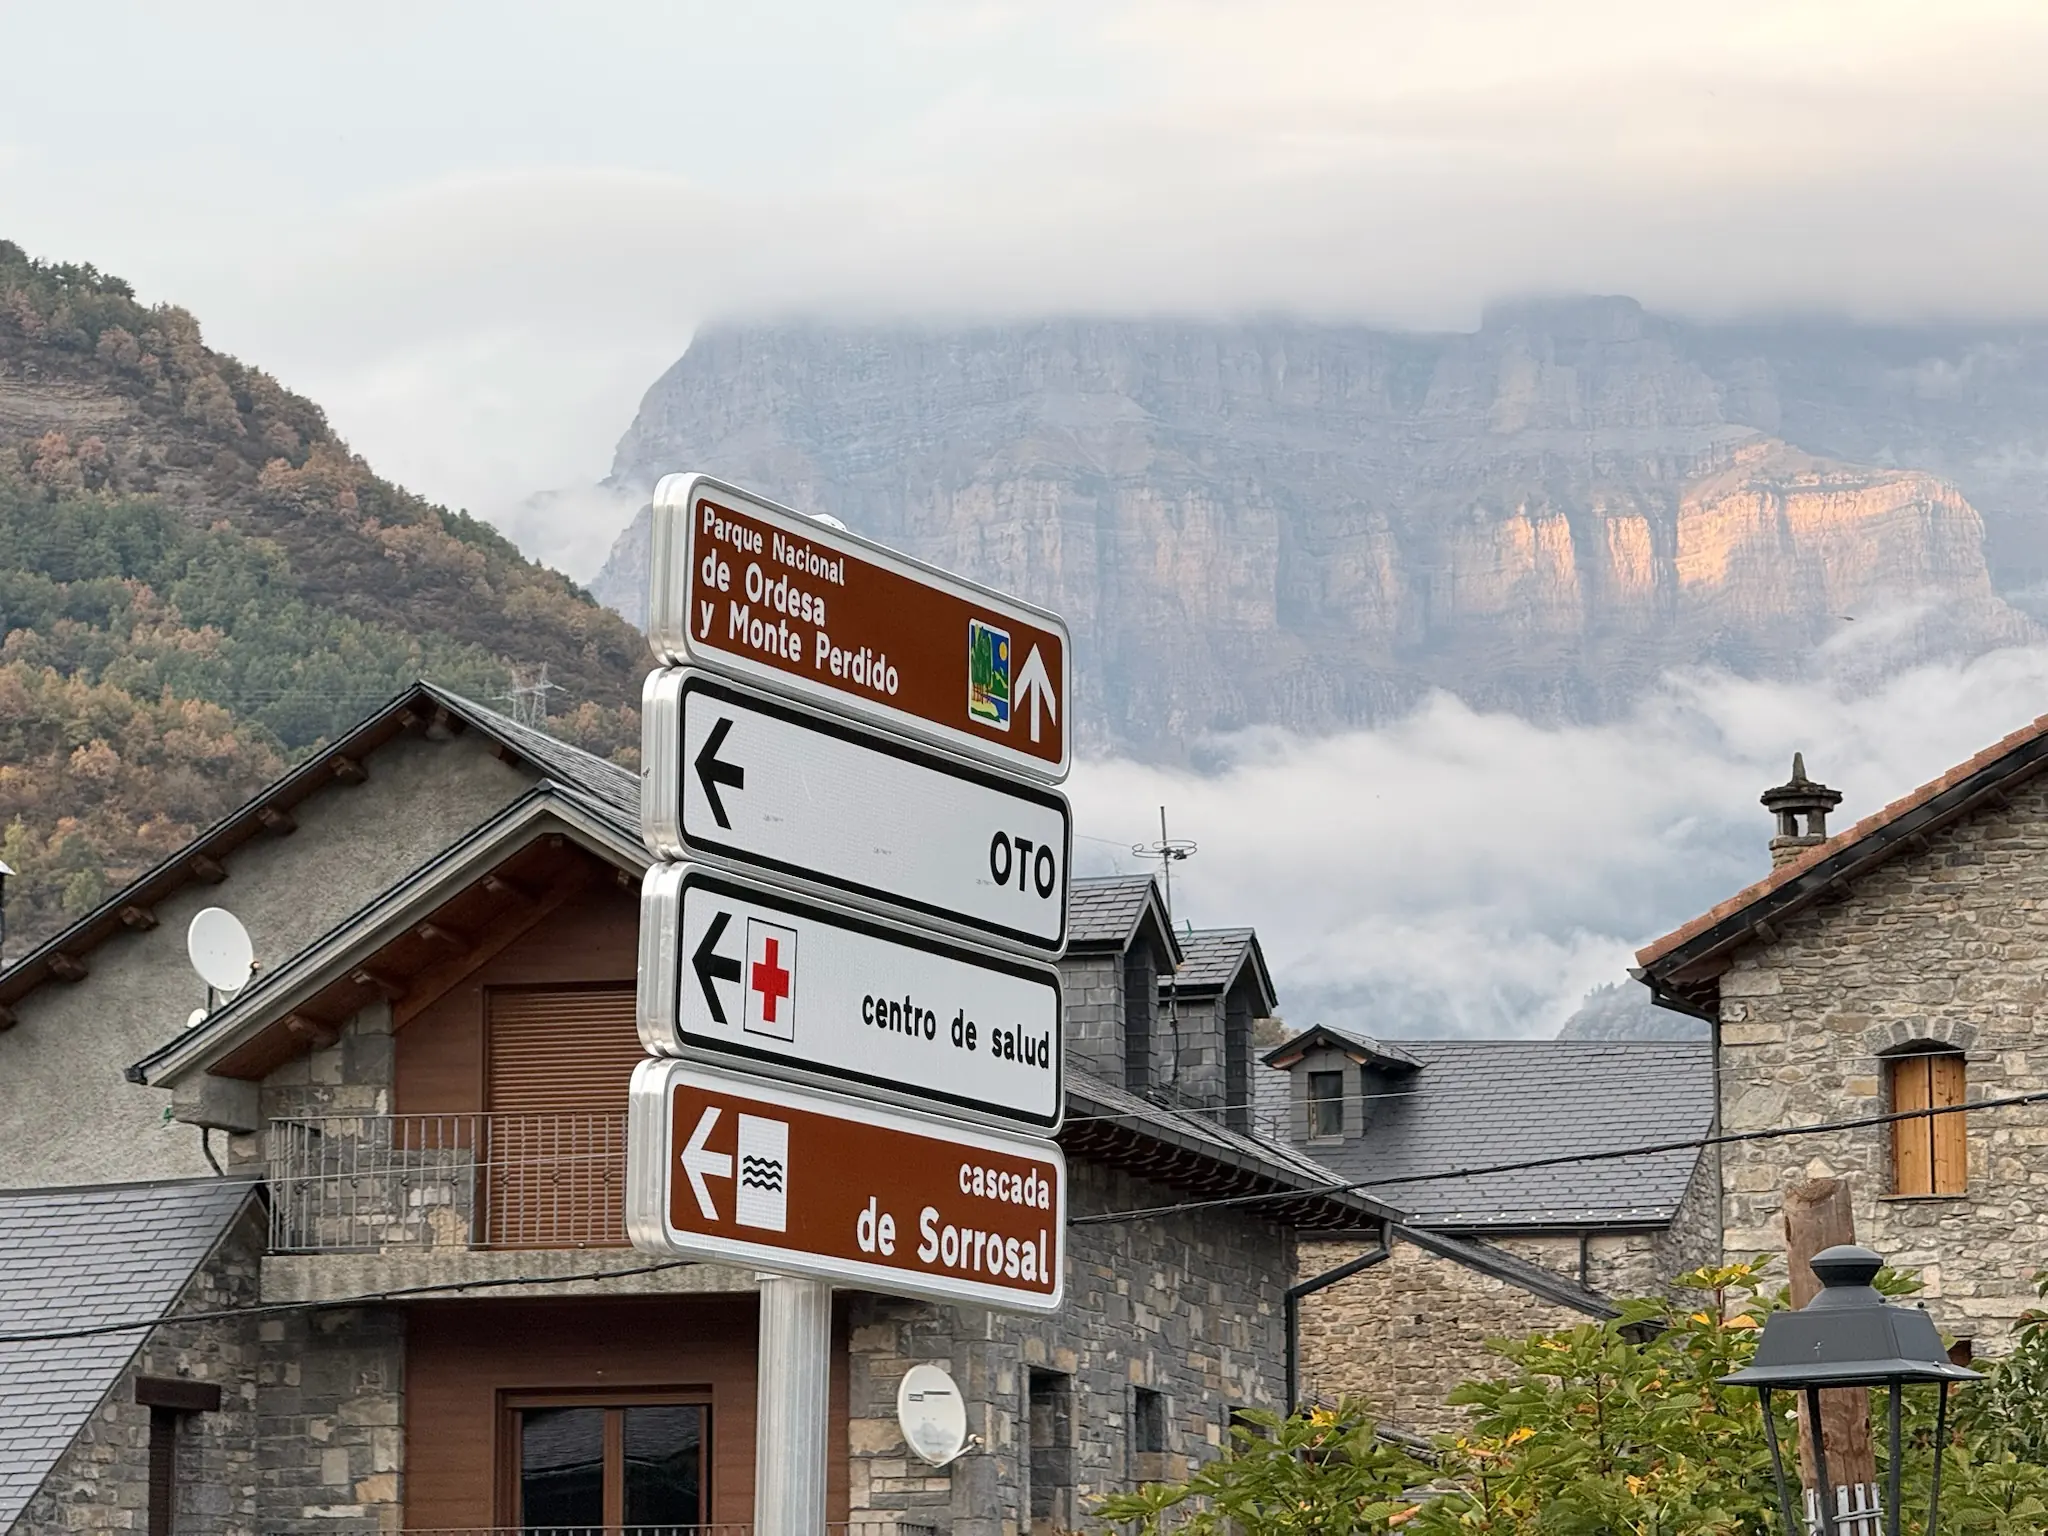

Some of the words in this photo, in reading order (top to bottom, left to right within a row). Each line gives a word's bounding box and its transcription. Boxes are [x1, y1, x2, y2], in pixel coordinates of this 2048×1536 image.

[703, 506, 763, 554] Parque
[773, 532, 844, 586] Nacional
[702, 548, 730, 592] de
[745, 563, 825, 626] Ordesa
[700, 600, 714, 638] y
[729, 601, 801, 662] Monte
[815, 632, 898, 696] Perdido
[990, 831, 1055, 899] OTO
[862, 994, 936, 1041] centro
[951, 1008, 977, 1051] de
[991, 1023, 1050, 1070] salud
[959, 1162, 1050, 1210] cascada
[856, 1196, 896, 1256] de
[917, 1206, 1049, 1285] Sorrosal
